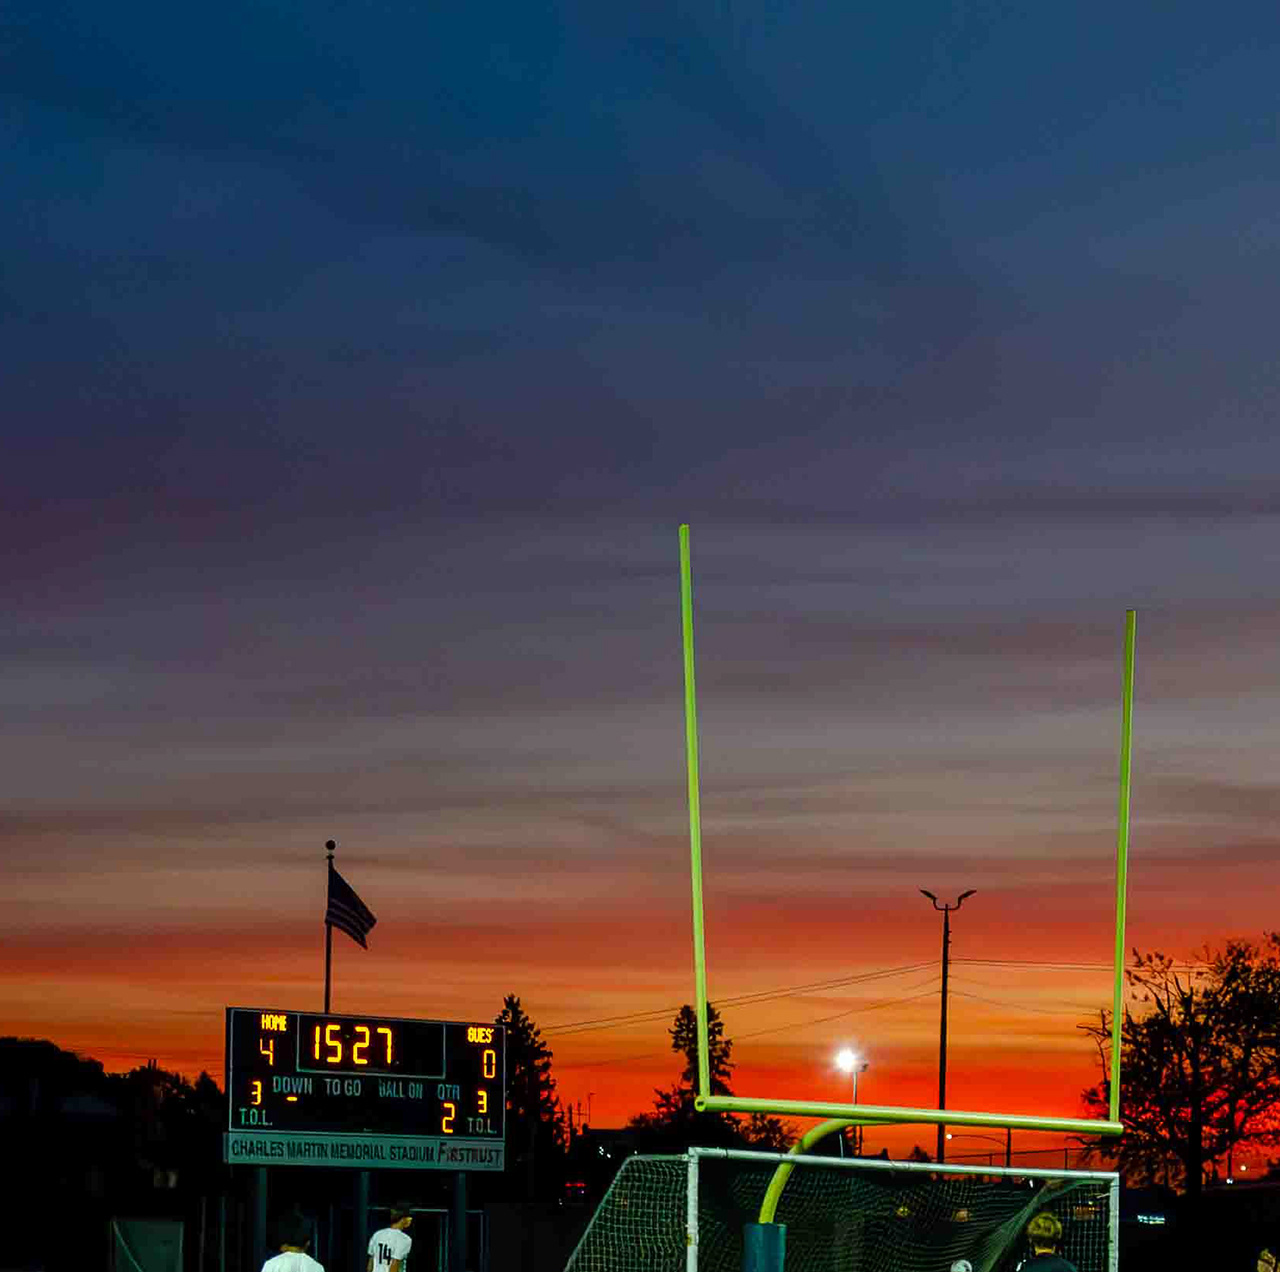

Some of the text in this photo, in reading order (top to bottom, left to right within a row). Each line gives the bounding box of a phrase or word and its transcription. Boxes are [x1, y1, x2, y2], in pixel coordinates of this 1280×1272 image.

[261, 1014, 287, 1032] HOME
[260, 1038, 274, 1066] 4
[483, 1049, 496, 1079] 0
[250, 1080, 262, 1106] 3
[273, 1076, 313, 1095] DOWN
[324, 1078, 362, 1097] TO GO
[378, 1078, 423, 1099] BALL ON
[437, 1083, 460, 1101] QTR
[477, 1090, 488, 1114] 3
[442, 1102, 456, 1134] 2
[231, 1139, 435, 1162] CHARLES MARTIN MEMORIAL STADIUM
[378, 1243, 392, 1265] 14
